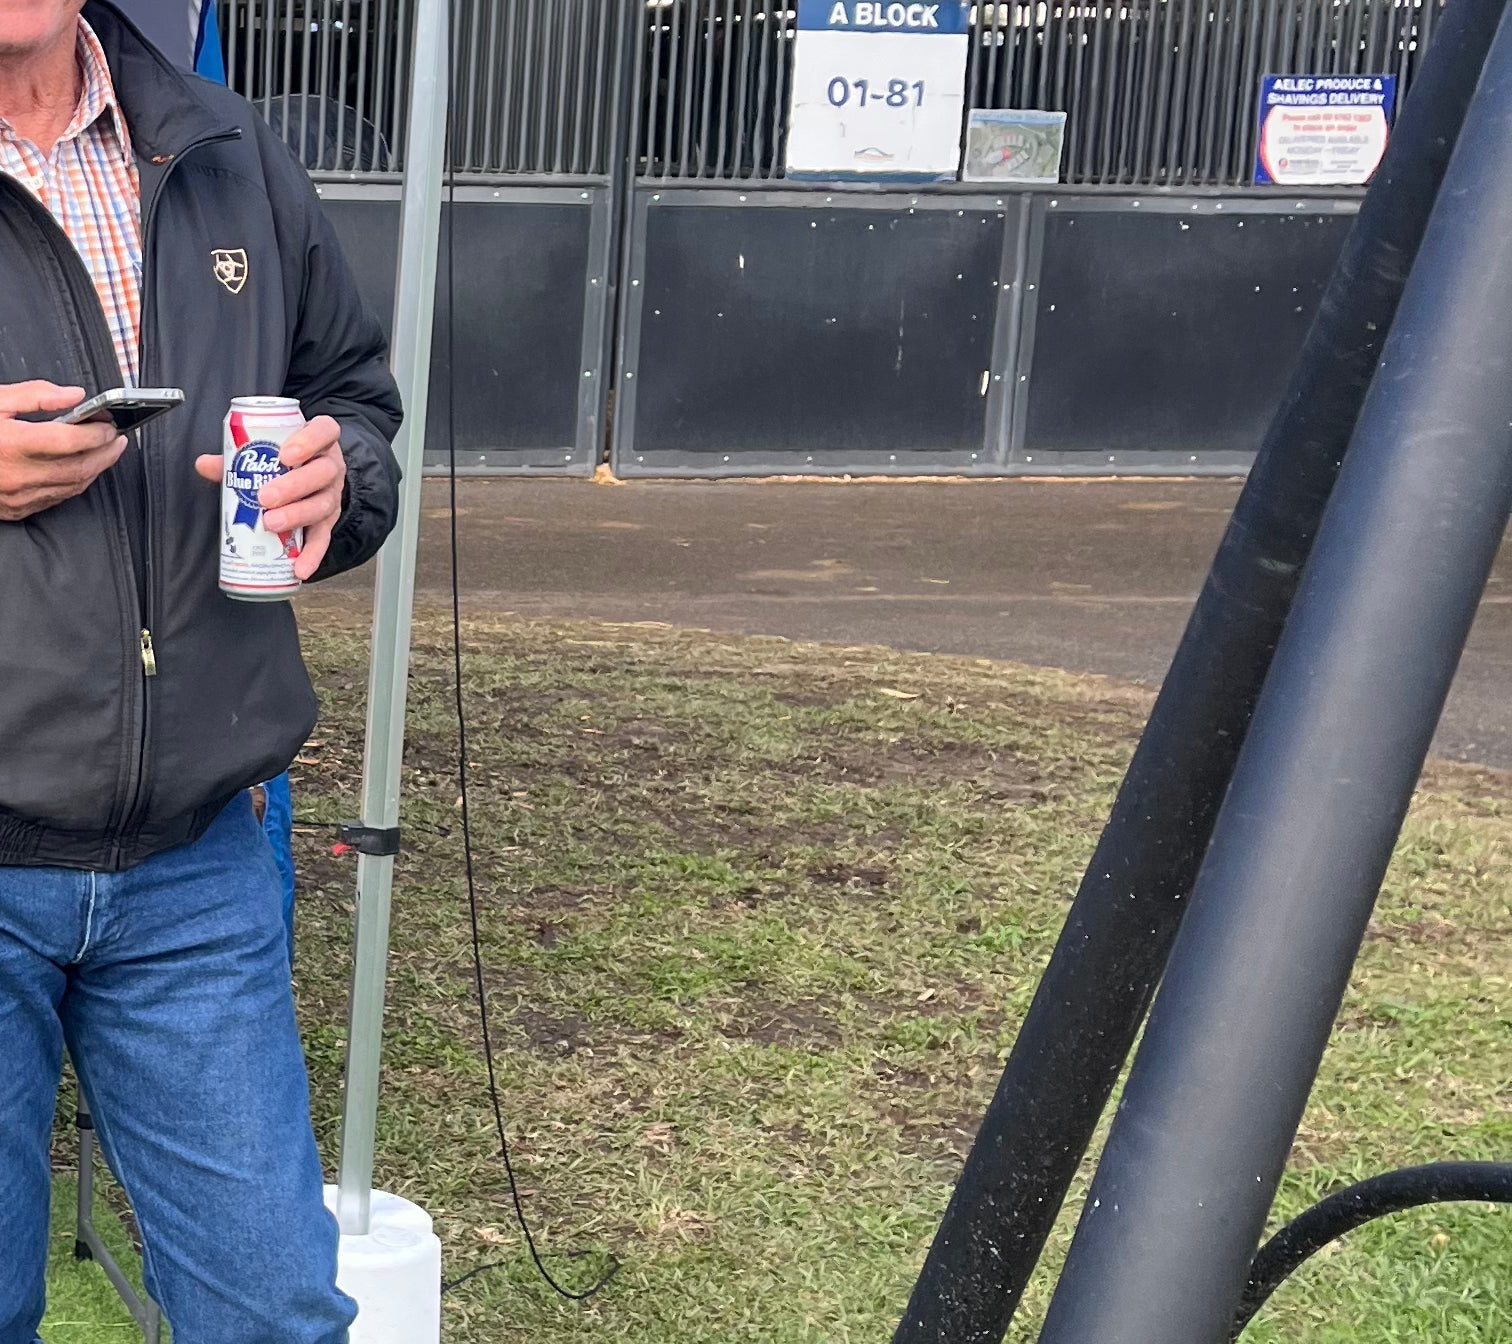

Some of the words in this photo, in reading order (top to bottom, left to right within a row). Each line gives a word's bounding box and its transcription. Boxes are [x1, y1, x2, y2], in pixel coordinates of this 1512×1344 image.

[829, 2, 849, 25] A
[855, 3, 940, 27] BLOCK
[827, 76, 925, 107] 01-81
[1315, 78, 1371, 90] PRODUCE
[1267, 92, 1327, 105] SHAVINGS
[1328, 93, 1385, 105] DELIVERY
[240, 449, 281, 472] Pabst
[226, 471, 252, 490] Blue
